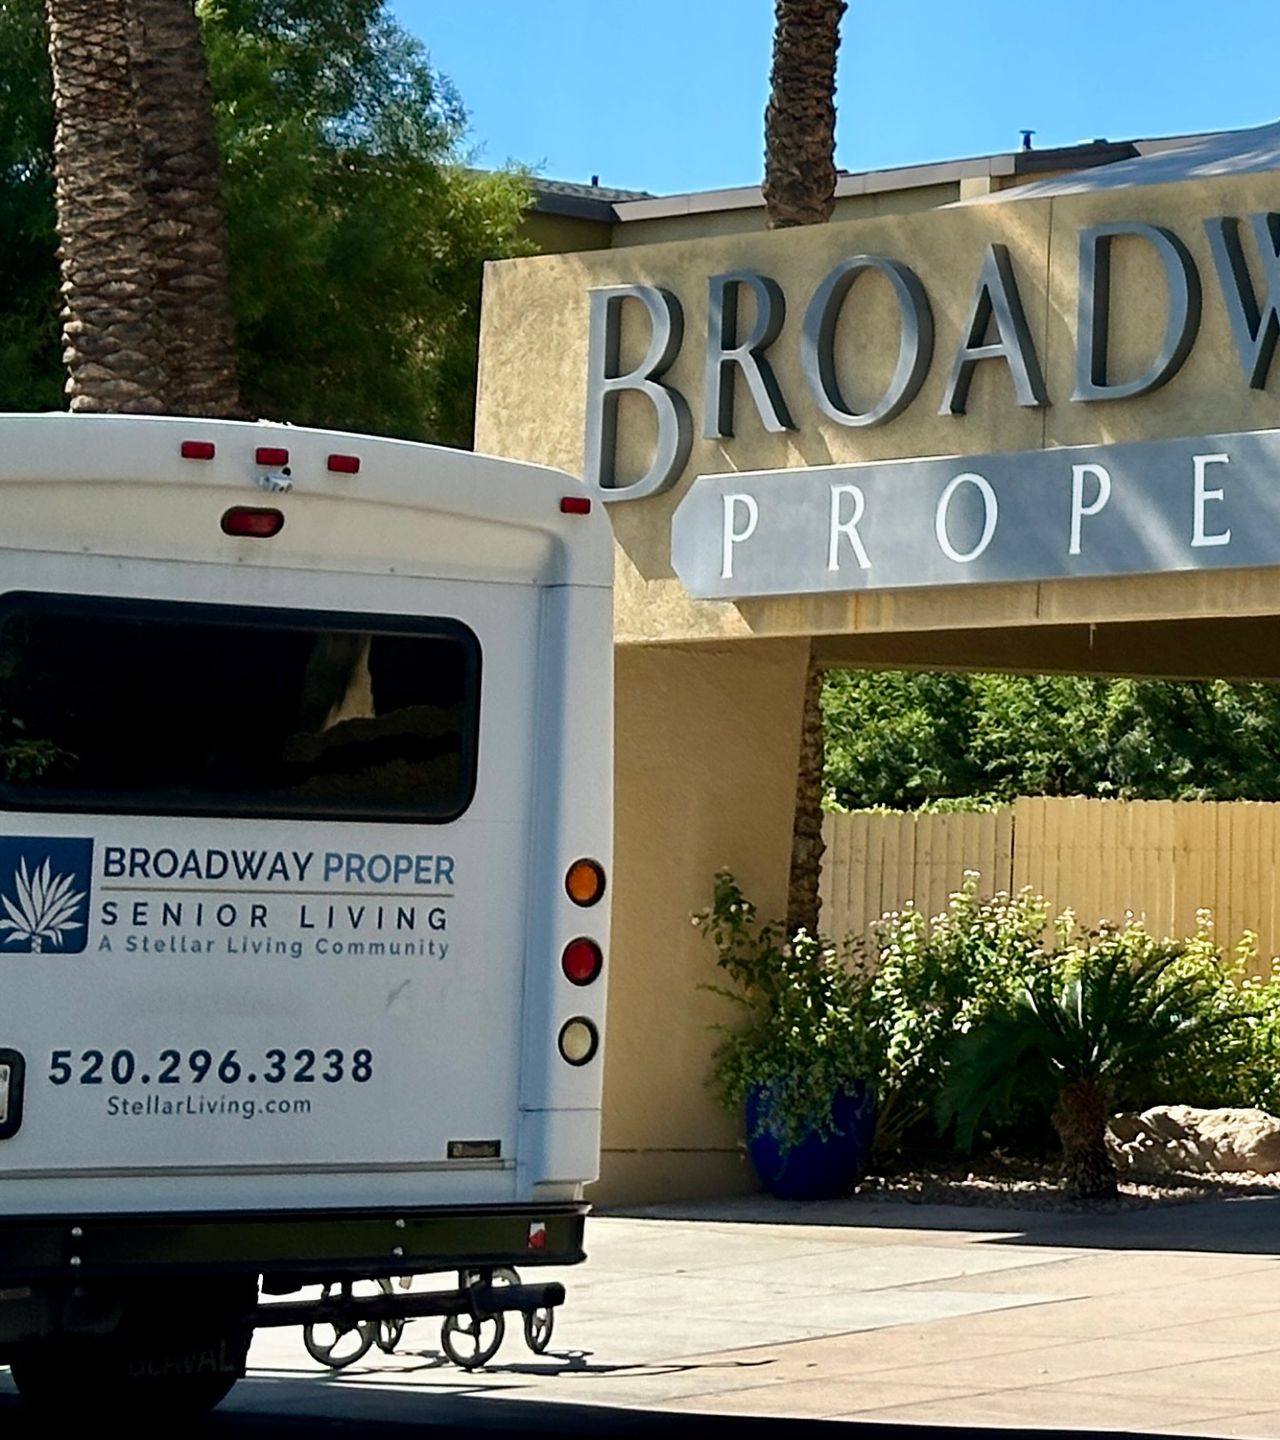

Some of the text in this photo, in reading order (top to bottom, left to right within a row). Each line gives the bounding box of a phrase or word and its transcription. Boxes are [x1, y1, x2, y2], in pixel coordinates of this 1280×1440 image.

[103, 846, 455, 885] BROADWAY PROPER
[100, 901, 447, 930] SENIOR LIVING
[98, 934, 450, 960] A Stellar Living Community
[49, 1048, 374, 1085] 520.296.3238
[106, 1094, 312, 1119] StellarLiving.com
